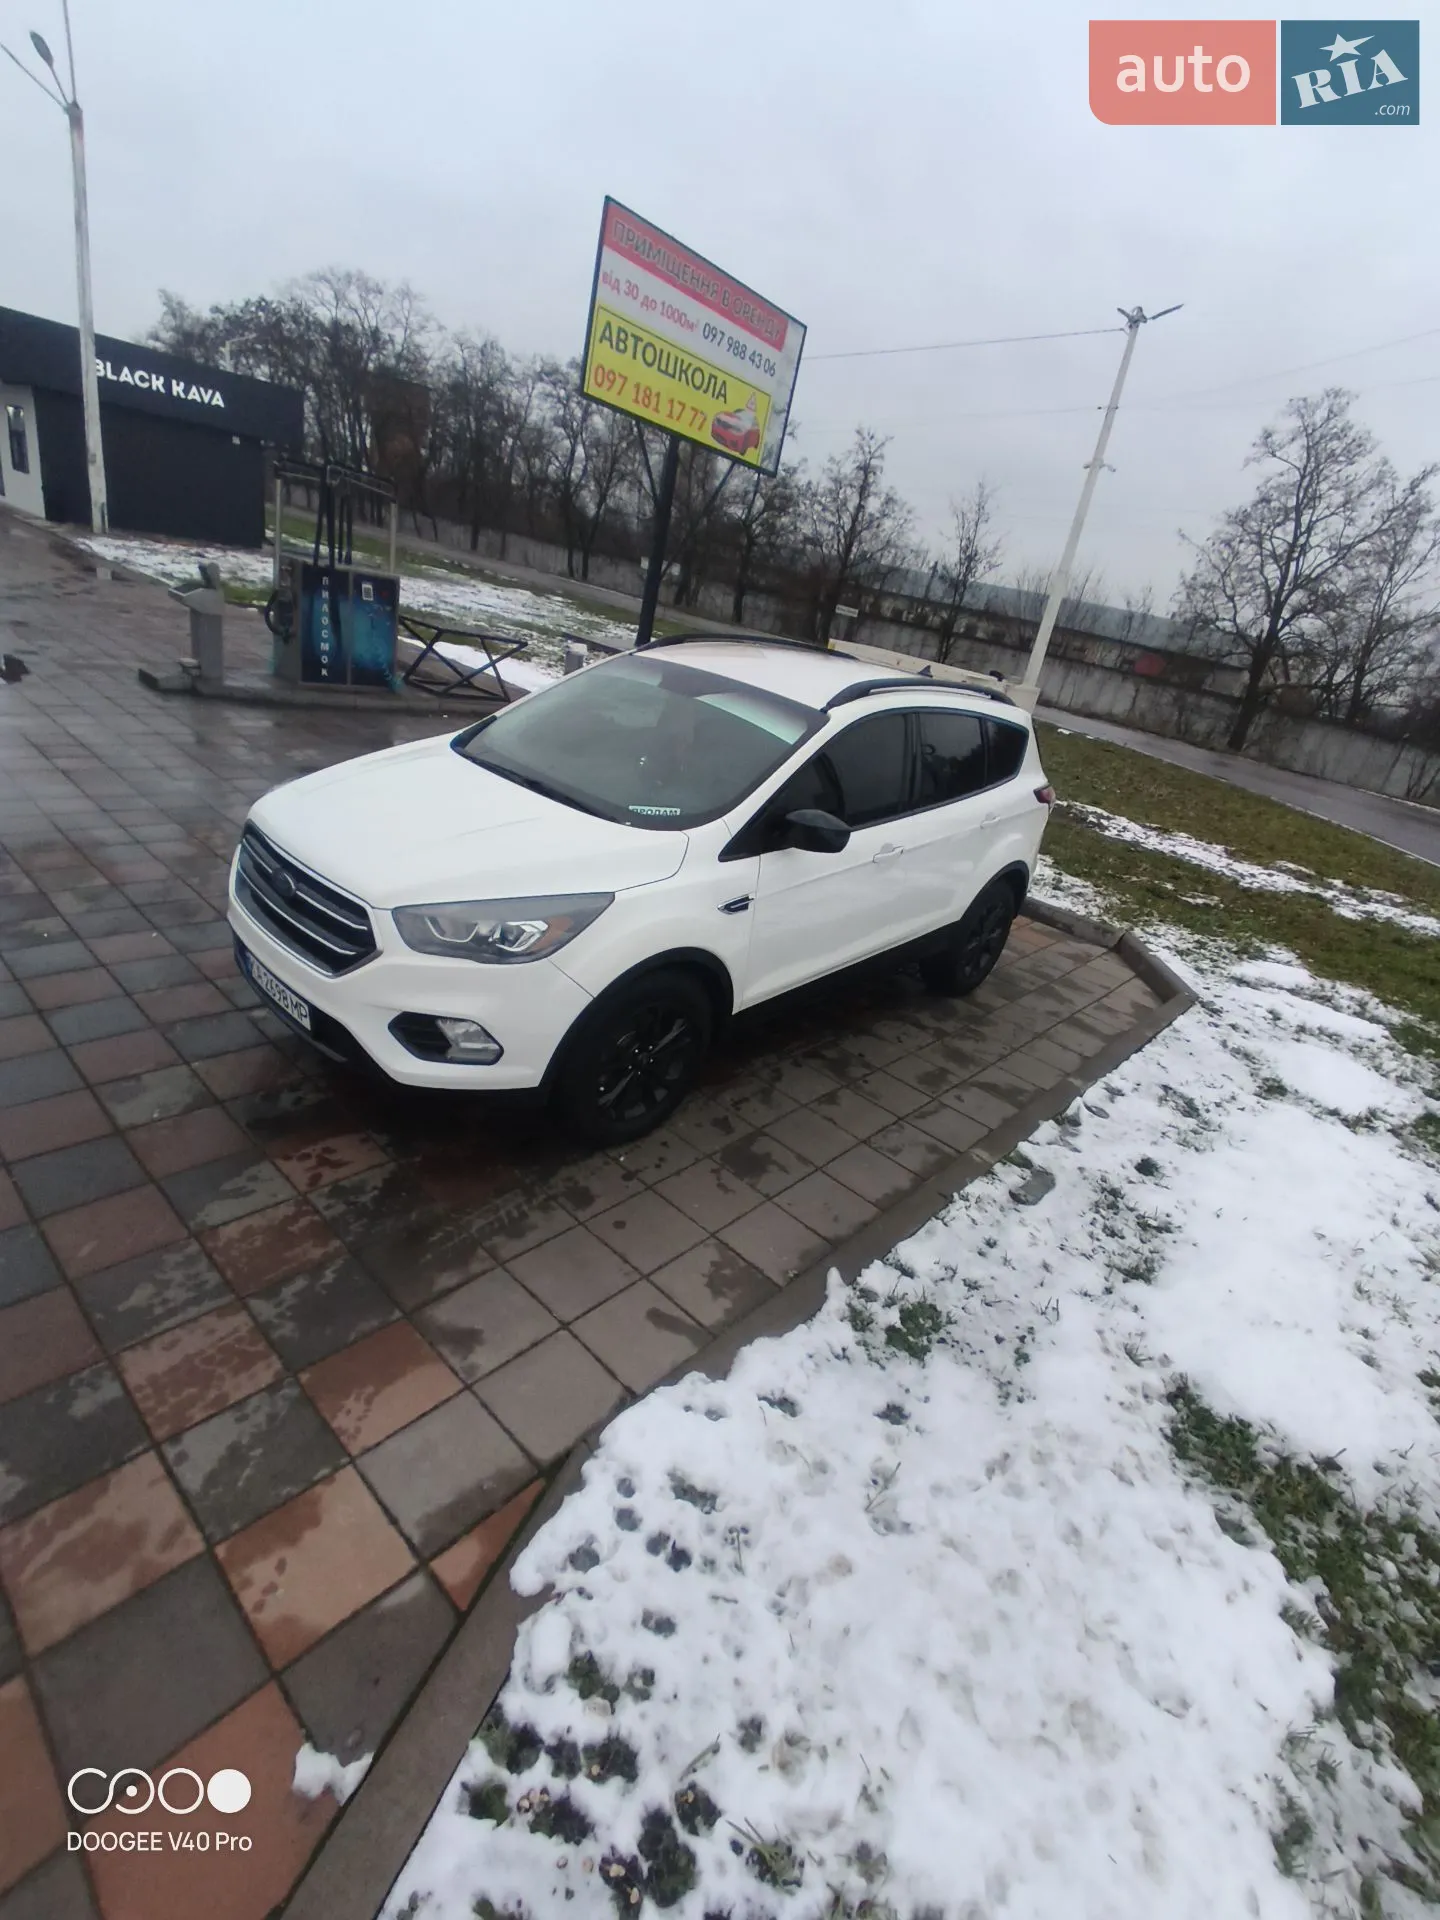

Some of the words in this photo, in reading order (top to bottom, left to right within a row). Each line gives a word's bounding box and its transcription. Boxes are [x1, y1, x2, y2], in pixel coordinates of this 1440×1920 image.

[602, 270, 620, 296] від
[624, 279, 639, 300] 30
[640, 295, 657, 311] до
[613, 219, 719, 300] ПРИМІЩЕННЯ
[722, 286, 731, 309] В
[95, 358, 166, 394] BLACK
[171, 379, 225, 408] KAVA
[598, 320, 727, 404] АВТОШКОЛА
[702, 322, 725, 347] 097
[726, 336, 747, 360] 988
[748, 350, 763, 369] 43
[763, 358, 776, 377] 06
[594, 363, 628, 396] 097
[632, 381, 661, 414] 181
[666, 397, 686, 423] 17
[688, 406, 708, 432] 77
[320, 576, 329, 677] ПИЛОСМОК
